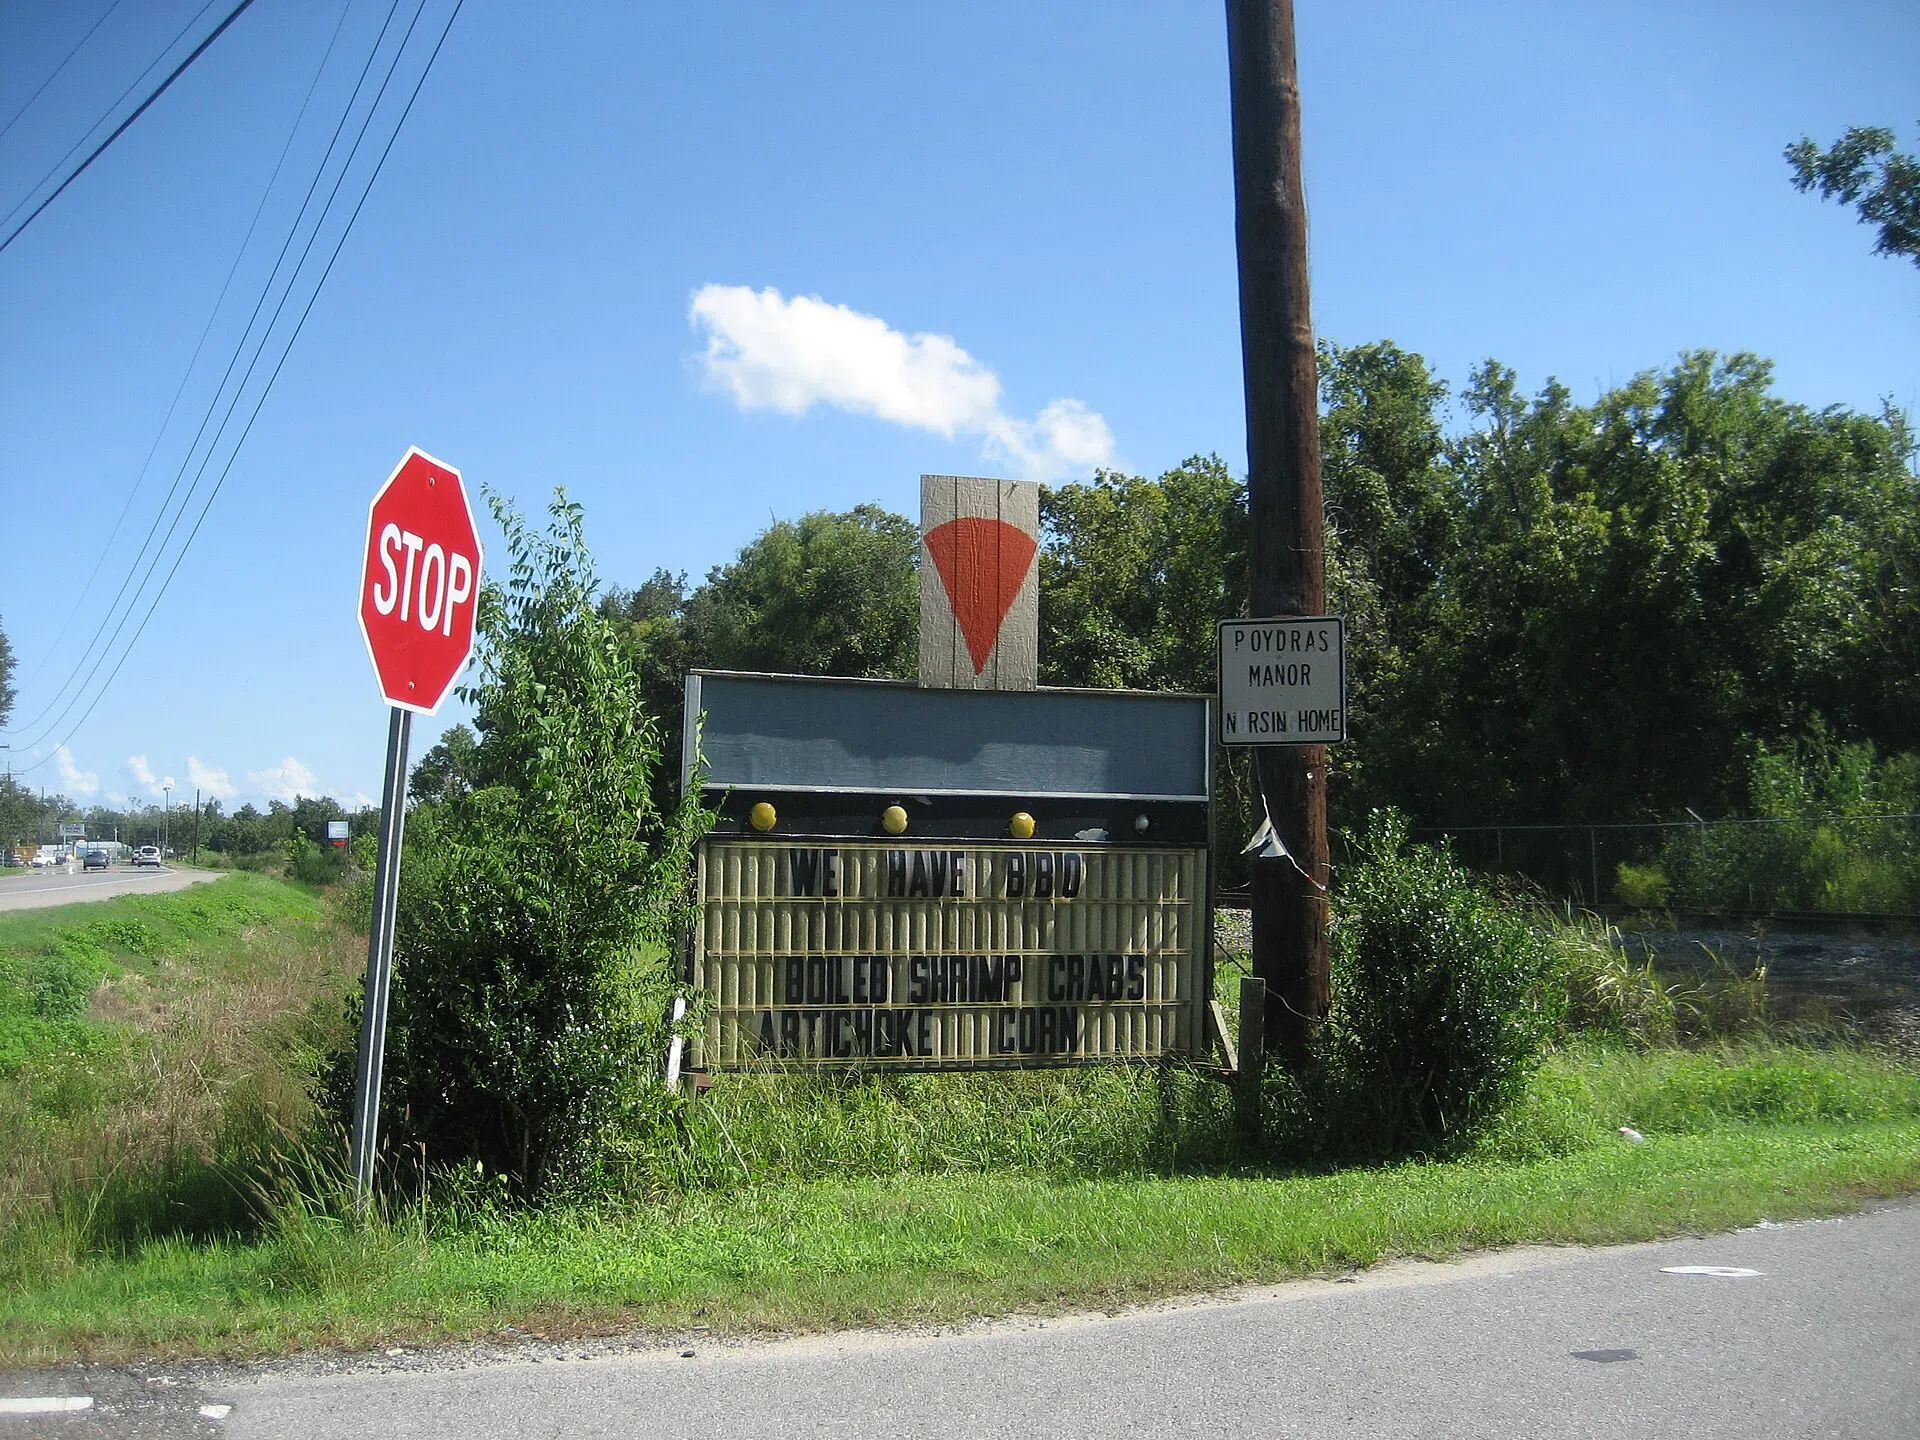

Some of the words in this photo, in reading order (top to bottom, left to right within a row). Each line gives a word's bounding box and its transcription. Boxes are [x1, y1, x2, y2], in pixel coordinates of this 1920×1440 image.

[374, 523, 472, 637] STOP
[1234, 630, 1329, 652] POYDRAS
[1249, 664, 1311, 687] MANOR
[1298, 709, 1340, 732] HOME
[789, 849, 838, 898] WE
[888, 850, 965, 898] HAVE
[910, 955, 1021, 1003] SHRIMP
[1049, 954, 1144, 1001] CRABS
[759, 1009, 933, 1058] ARTICHOKE
[998, 1006, 1078, 1055] CORN
